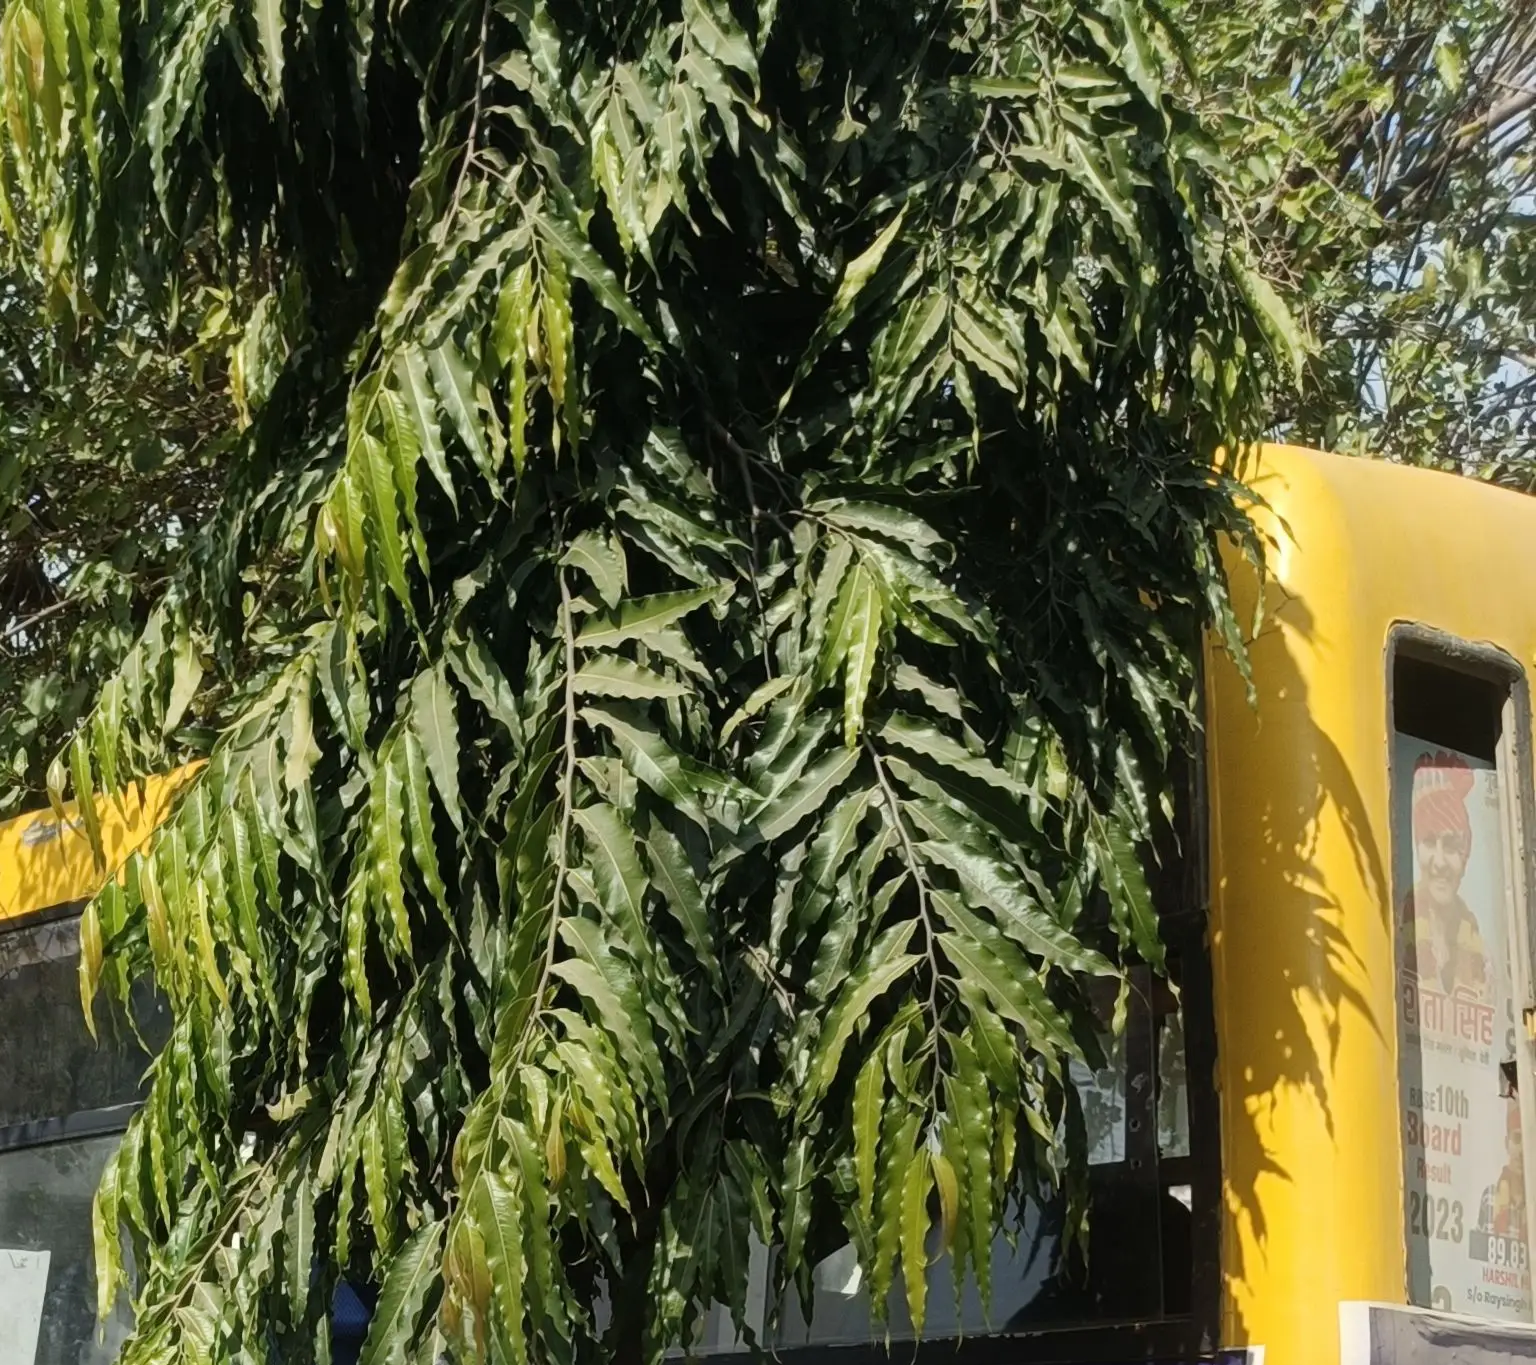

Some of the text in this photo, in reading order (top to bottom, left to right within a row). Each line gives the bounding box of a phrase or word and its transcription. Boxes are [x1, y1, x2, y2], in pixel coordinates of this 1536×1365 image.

[1407, 1110, 1462, 1156] Board
[1416, 1157, 1452, 1185] Result
[1410, 1190, 1464, 1244] 2023
